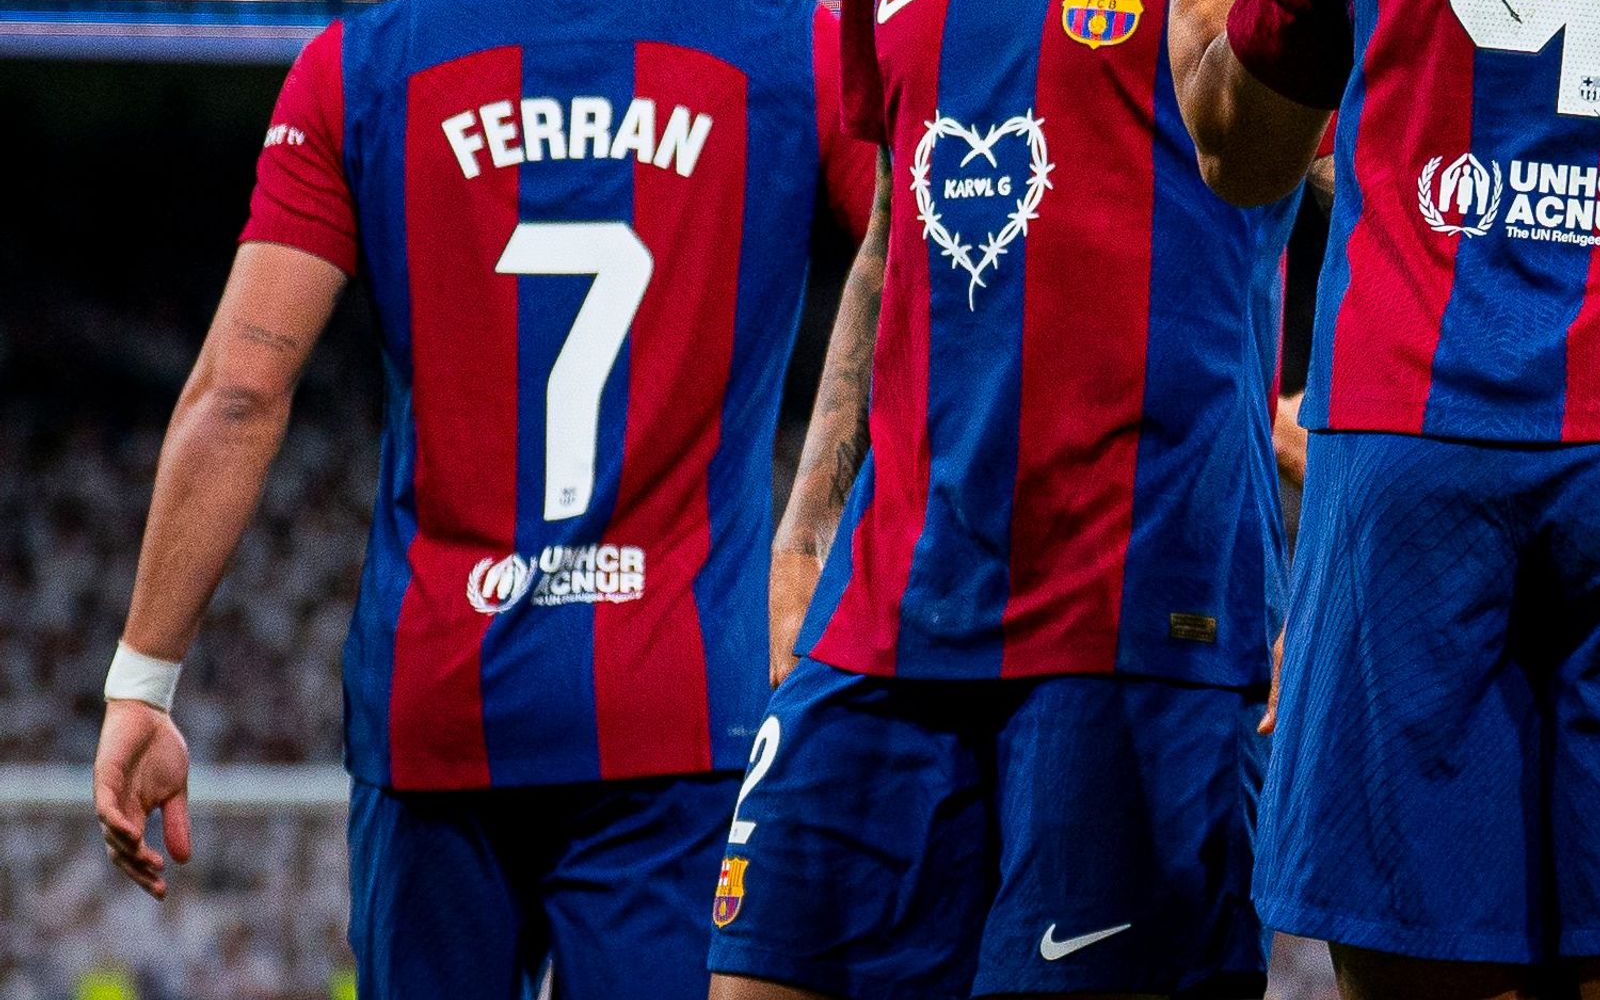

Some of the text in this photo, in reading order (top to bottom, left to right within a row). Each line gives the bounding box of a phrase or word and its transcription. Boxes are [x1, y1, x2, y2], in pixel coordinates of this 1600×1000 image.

[441, 96, 713, 180] FERRAN
[997, 175, 1012, 196] G
[1506, 226, 1530, 239] The
[1530, 229, 1551, 241] UN
[494, 221, 655, 522] 7
[727, 715, 781, 845] 2
